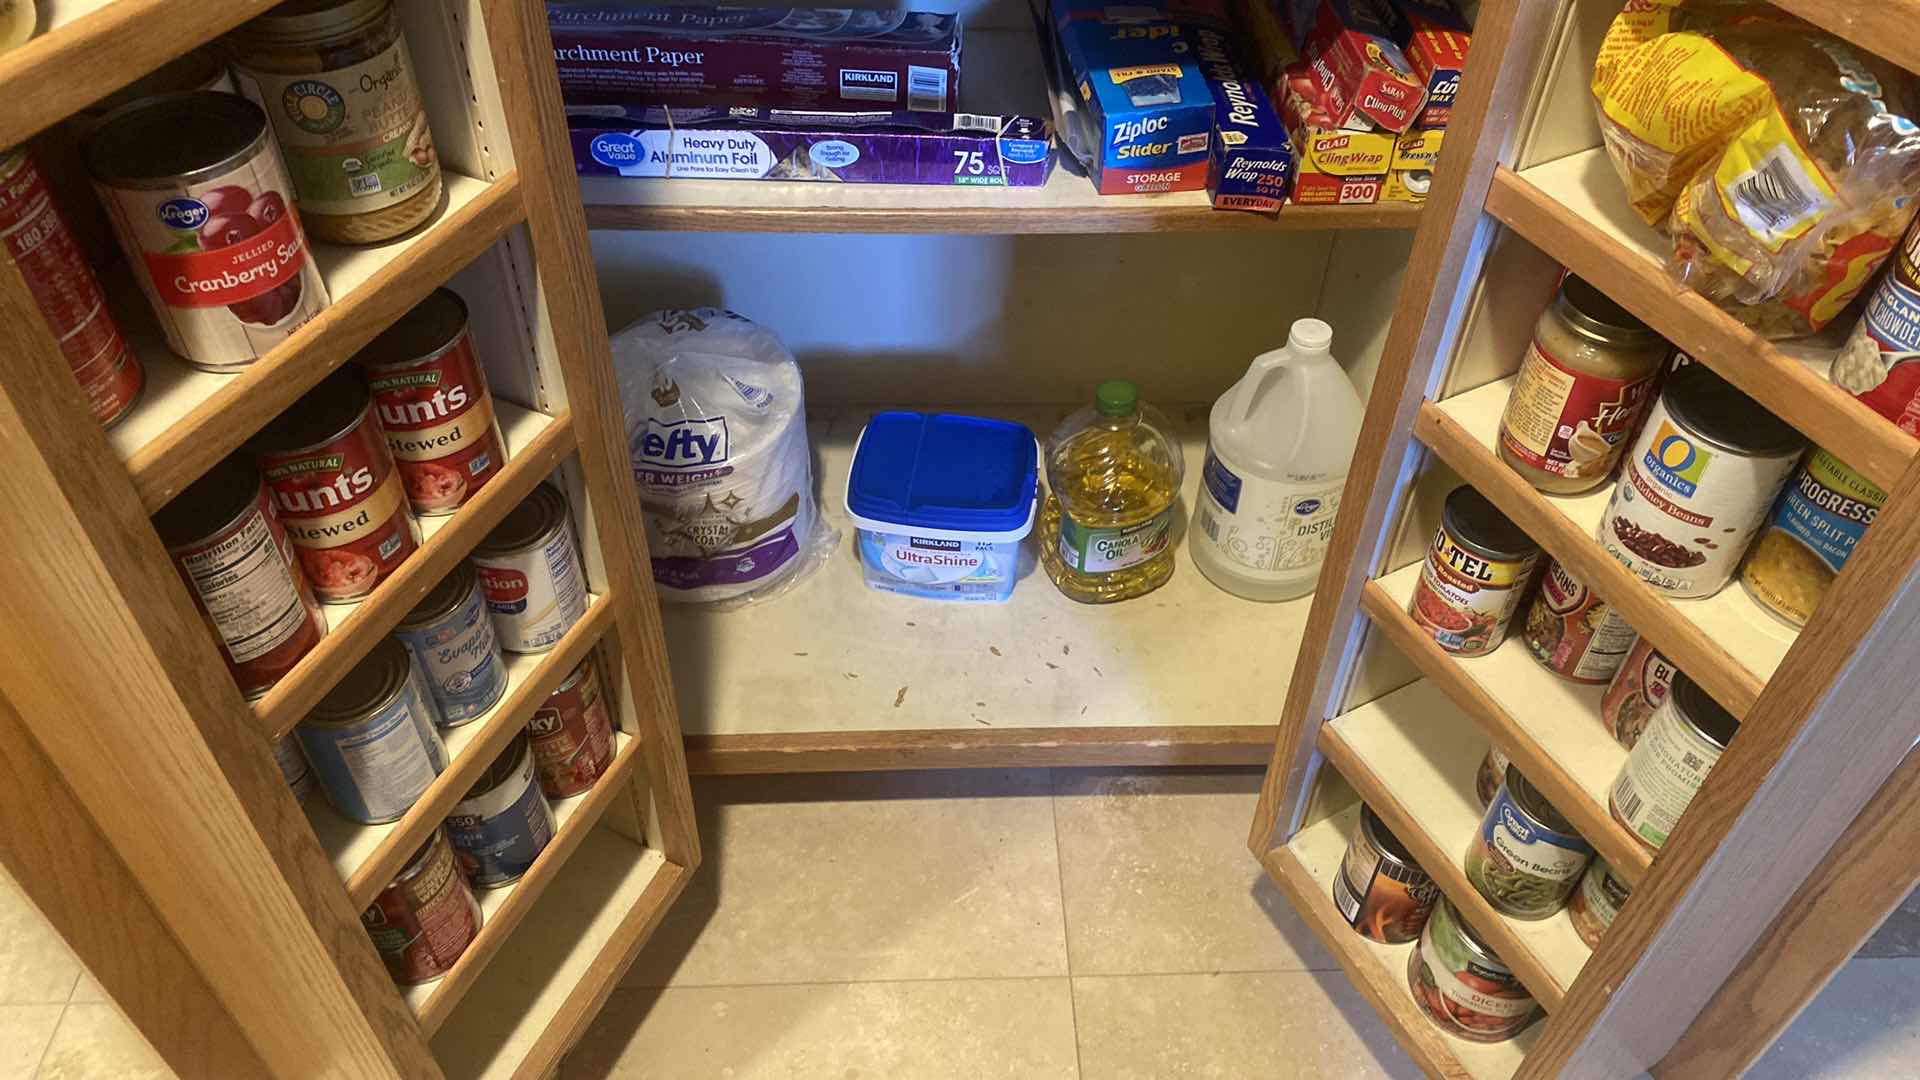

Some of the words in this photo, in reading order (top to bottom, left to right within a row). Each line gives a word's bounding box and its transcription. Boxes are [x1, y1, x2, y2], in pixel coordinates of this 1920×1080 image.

[556, 44, 641, 63] rchment
[646, 46, 705, 67] Paper
[844, 72, 894, 83] KIRKLAND
[293, 82, 339, 105] CIRCLE
[1430, 94, 1452, 102] WAX
[1114, 117, 1168, 145] Ziploc
[597, 140, 635, 153] Great
[683, 138, 724, 151] Heavy
[728, 138, 756, 151] Duty
[1117, 142, 1172, 159] Slider
[1317, 137, 1348, 151] GLAD
[1400, 139, 1424, 149] GLAD
[608, 151, 636, 160] Value
[650, 151, 728, 164] Aluminum
[732, 151, 758, 165] Foil
[954, 151, 985, 175] 75
[987, 166, 1000, 175] SQ
[1231, 157, 1287, 172] Reynolds
[1126, 173, 1181, 184] STORAGE
[1225, 168, 1258, 182] Wrap
[1257, 174, 1284, 187] 250
[1270, 188, 1281, 196] FT
[1342, 185, 1374, 199] 300
[1223, 197, 1274, 208] EVERYDAY
[160, 205, 205, 224] Kroger
[231, 240, 275, 265] JELLIED
[175, 258, 278, 293] Cranberry
[276, 238, 304, 265] Sau
[1875, 304, 1920, 348] CHOWDE
[392, 373, 437, 386] NATURAL
[643, 428, 721, 464] efty
[290, 459, 338, 473] NATURAL
[660, 471, 722, 485] WEIGHT
[1646, 454, 1691, 495] organics
[1850, 479, 1888, 503] CLASSI
[1636, 474, 1666, 510] Kidney
[1667, 502, 1706, 526] Beans
[287, 510, 370, 540] Stewed
[687, 525, 730, 537] CRYSTAL
[1297, 517, 1335, 537] DISTIL
[1810, 513, 1845, 541] SPLIT
[694, 535, 720, 546] COAT
[912, 537, 960, 548] KIRKLAND
[1097, 535, 1139, 552] CANOLA
[185, 536, 239, 565] Nutrition
[896, 550, 978, 567] UltraShine
[1105, 549, 1123, 560] OIL
[1449, 545, 1492, 581] TEL
[1437, 565, 1475, 592] Roasted
[1434, 576, 1469, 606] TOMATOES
[1496, 836, 1530, 868] Green
[1531, 862, 1573, 876] Beans
